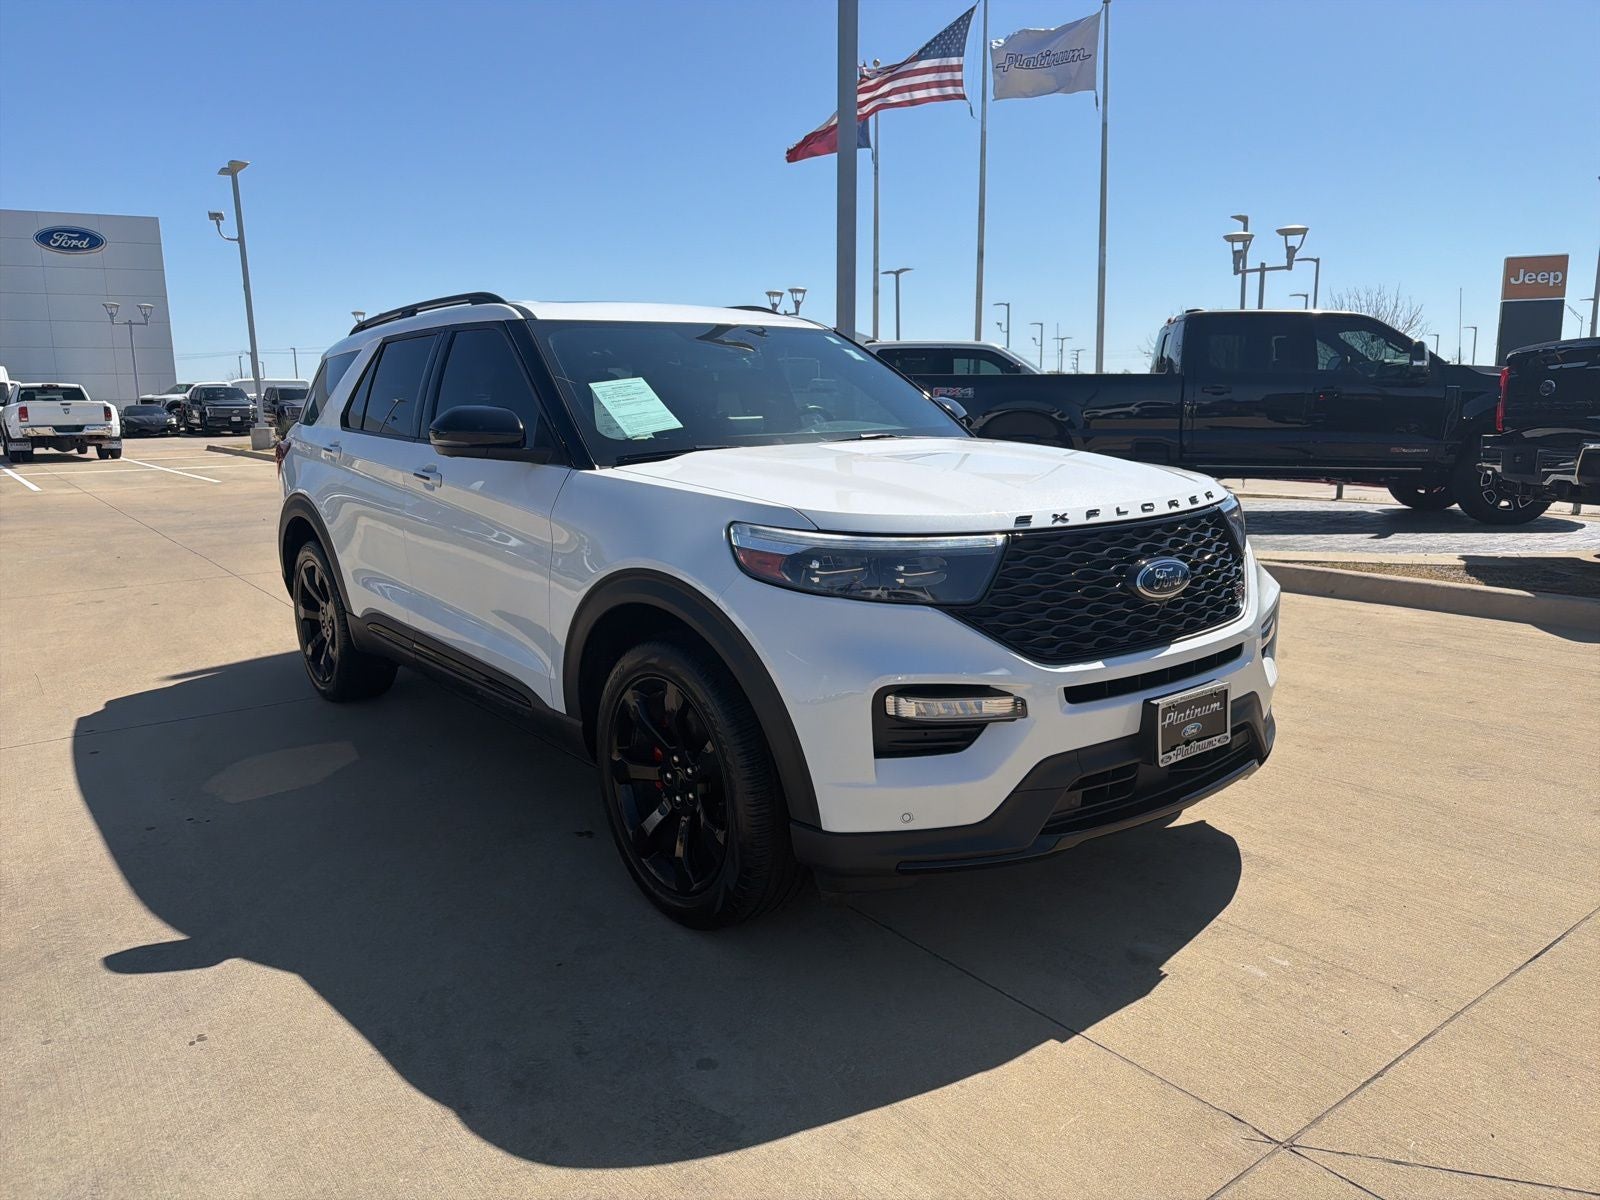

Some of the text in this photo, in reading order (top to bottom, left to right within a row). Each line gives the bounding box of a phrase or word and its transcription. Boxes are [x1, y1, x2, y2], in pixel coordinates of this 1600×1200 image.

[996, 47, 1092, 73] Platinum
[49, 232, 90, 248] Ford
[1510, 268, 1563, 287] Jeep
[933, 387, 974, 398] FX4
[1013, 490, 1215, 528] EXPLORER
[1153, 567, 1182, 590] Ford
[1161, 701, 1224, 728] Platinum
[1175, 740, 1215, 760] Platinum
